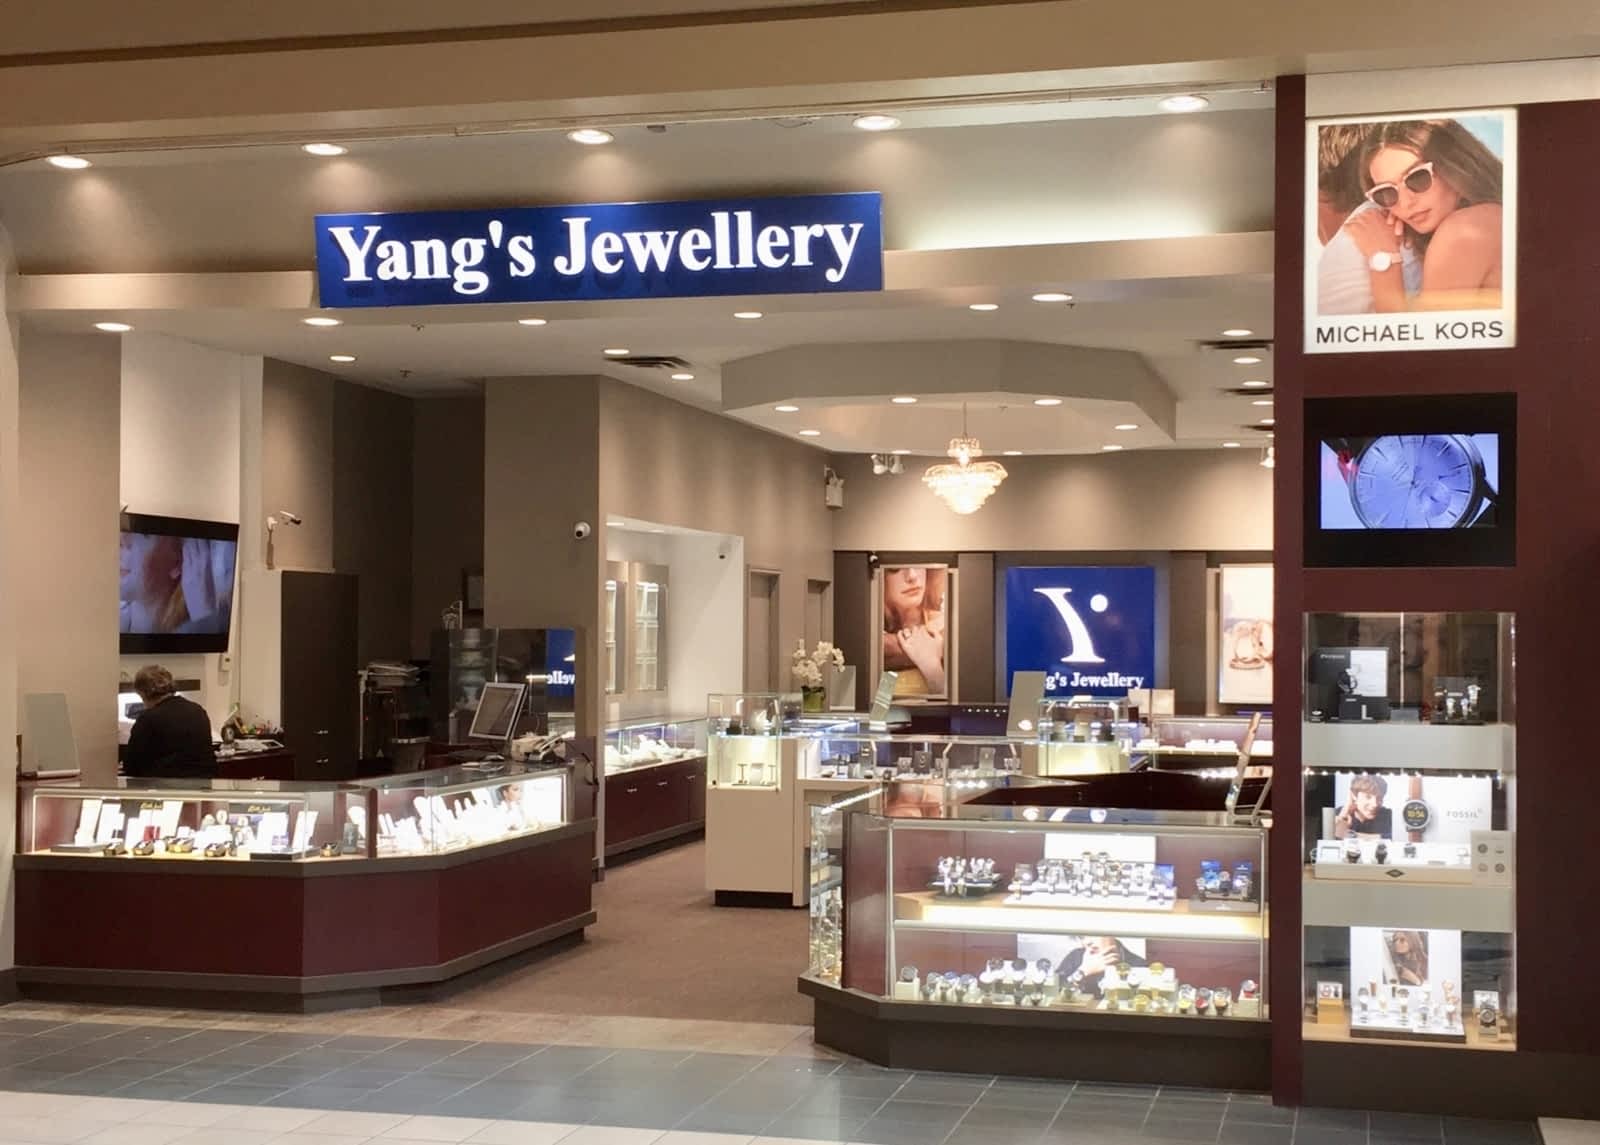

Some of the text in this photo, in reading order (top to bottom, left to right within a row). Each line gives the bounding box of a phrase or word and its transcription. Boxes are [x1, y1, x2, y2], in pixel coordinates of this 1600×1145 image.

[328, 210, 864, 295] Yang's Jewellery
[1316, 321, 1504, 343] MICHAEL KORS
[1045, 671, 1144, 690] g's Jewellery
